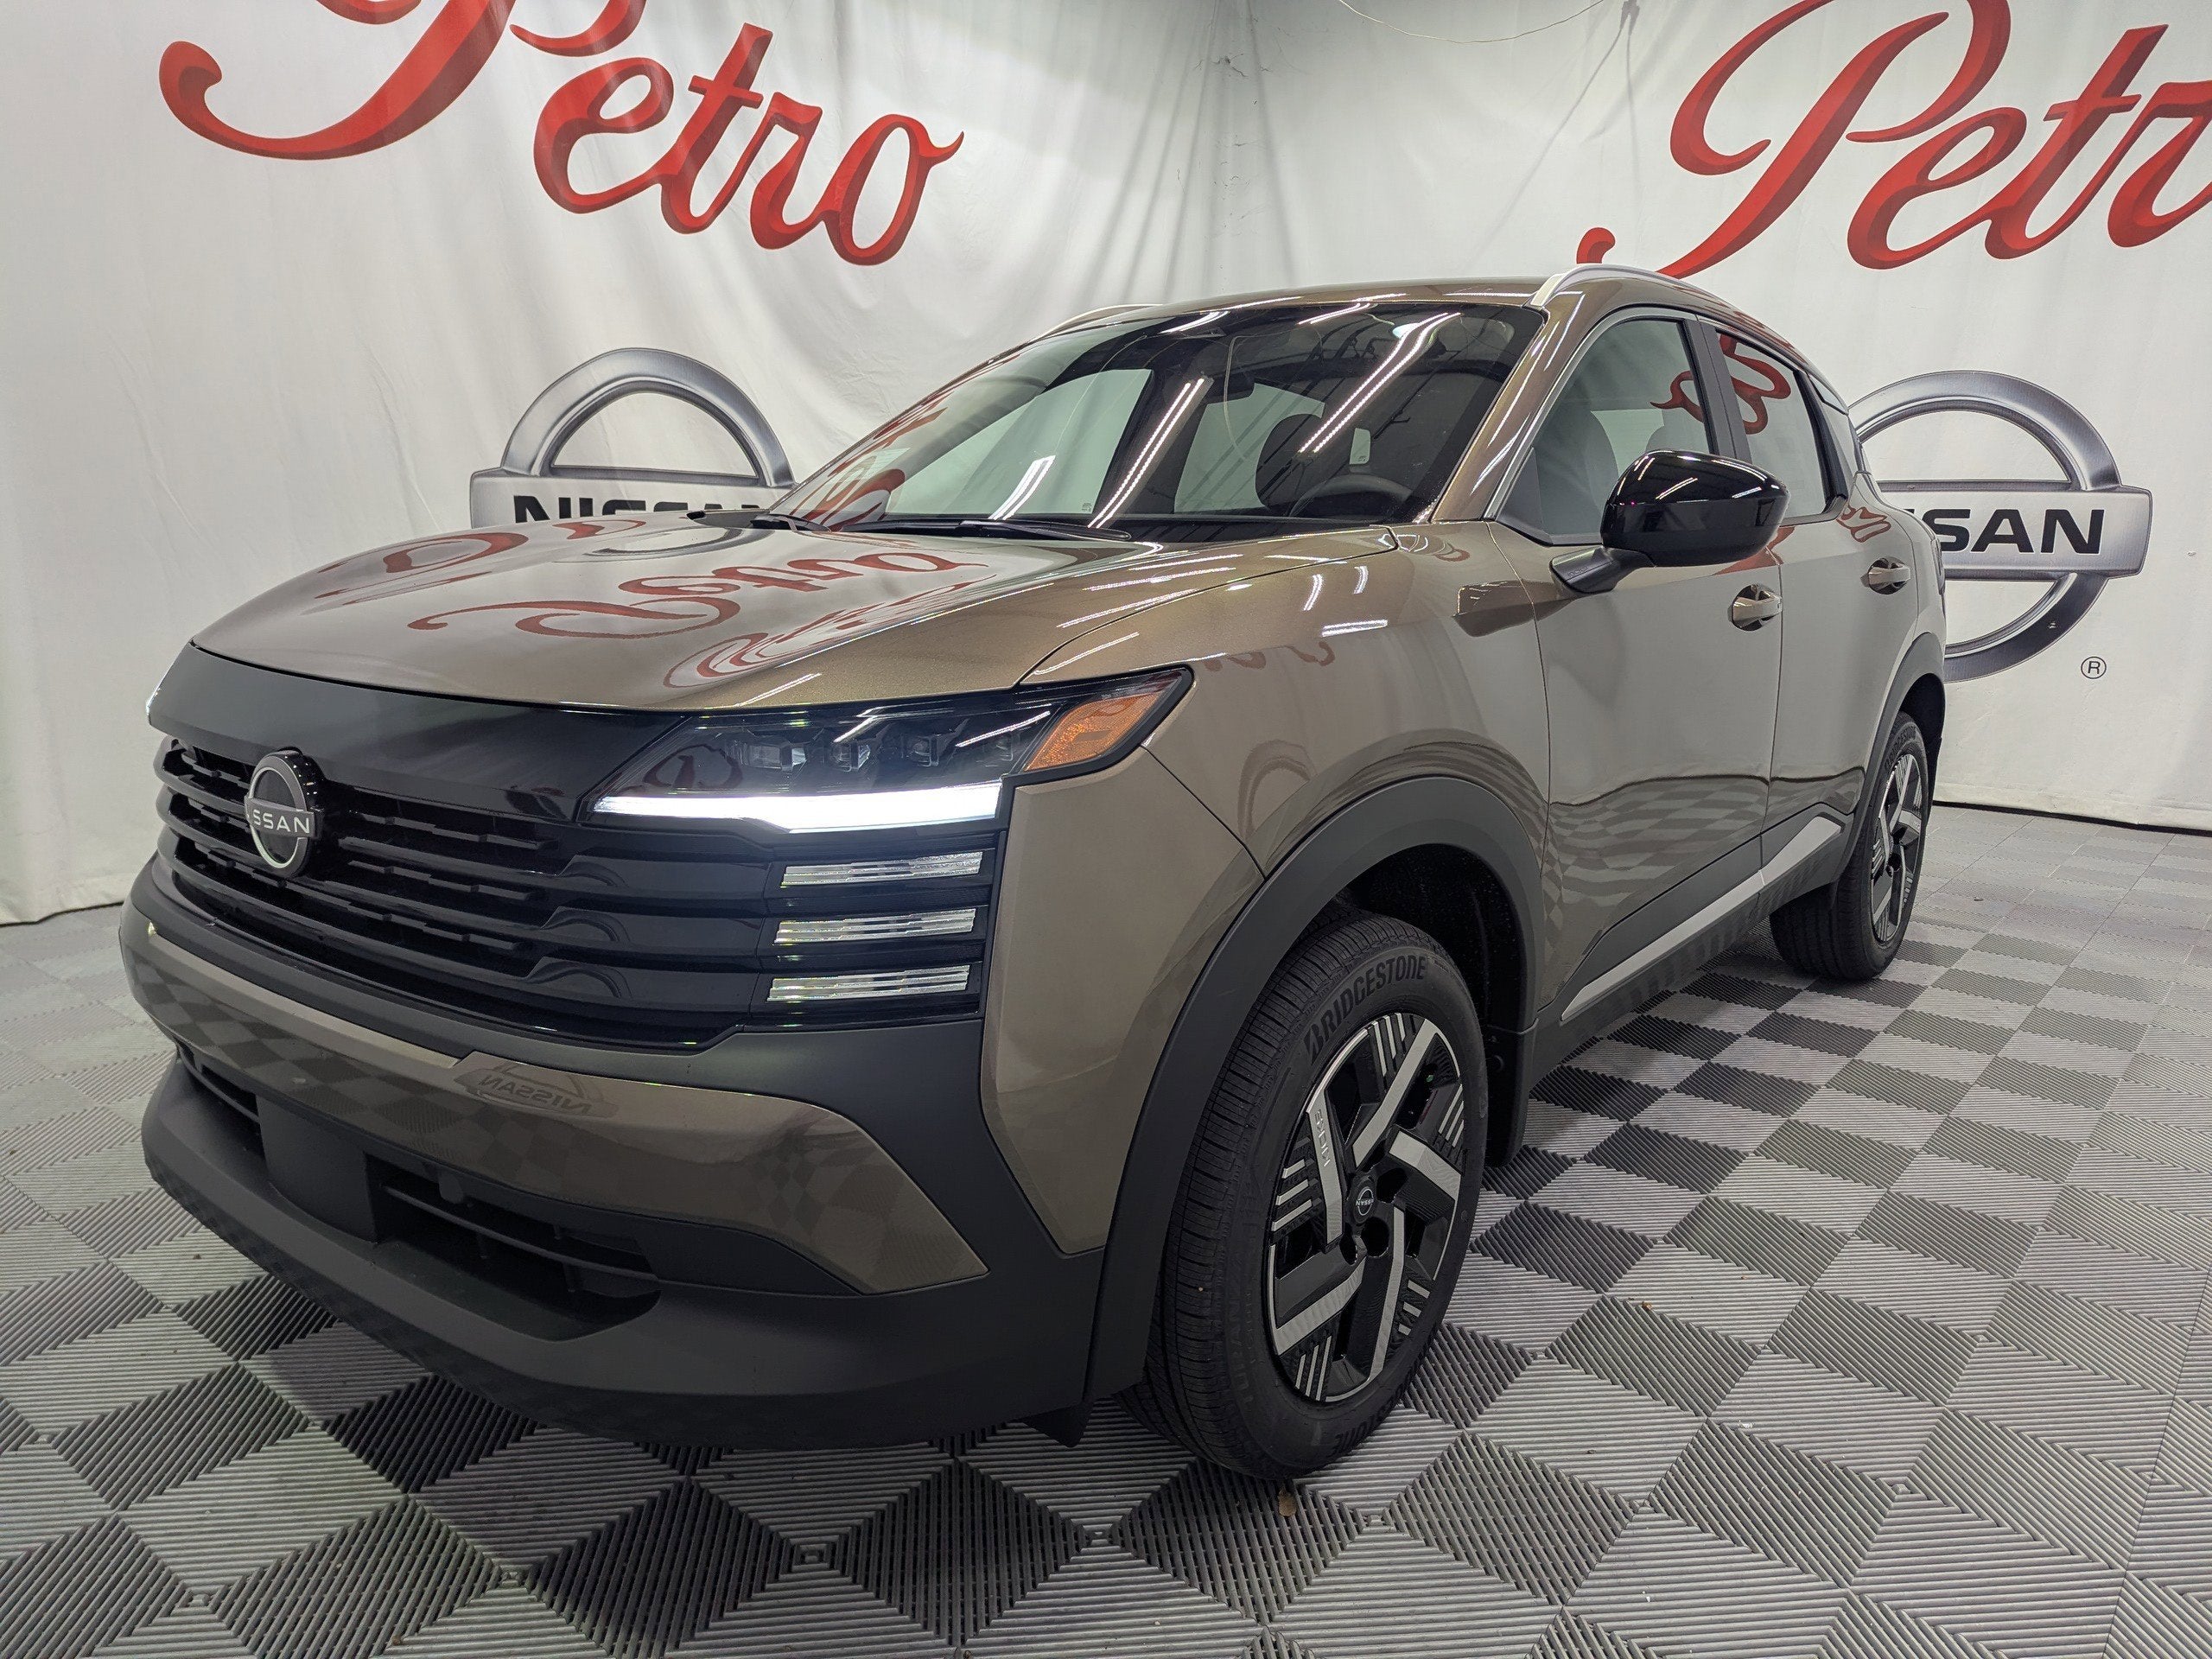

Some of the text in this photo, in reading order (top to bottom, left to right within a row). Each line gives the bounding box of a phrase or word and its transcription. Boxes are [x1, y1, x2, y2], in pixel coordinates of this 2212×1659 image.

[1576, 0, 2212, 277] Petr
[1904, 508, 2106, 555] SAN
[246, 808, 311, 835] SSAN
[1303, 955, 1427, 1066] BRIDGESTONE
